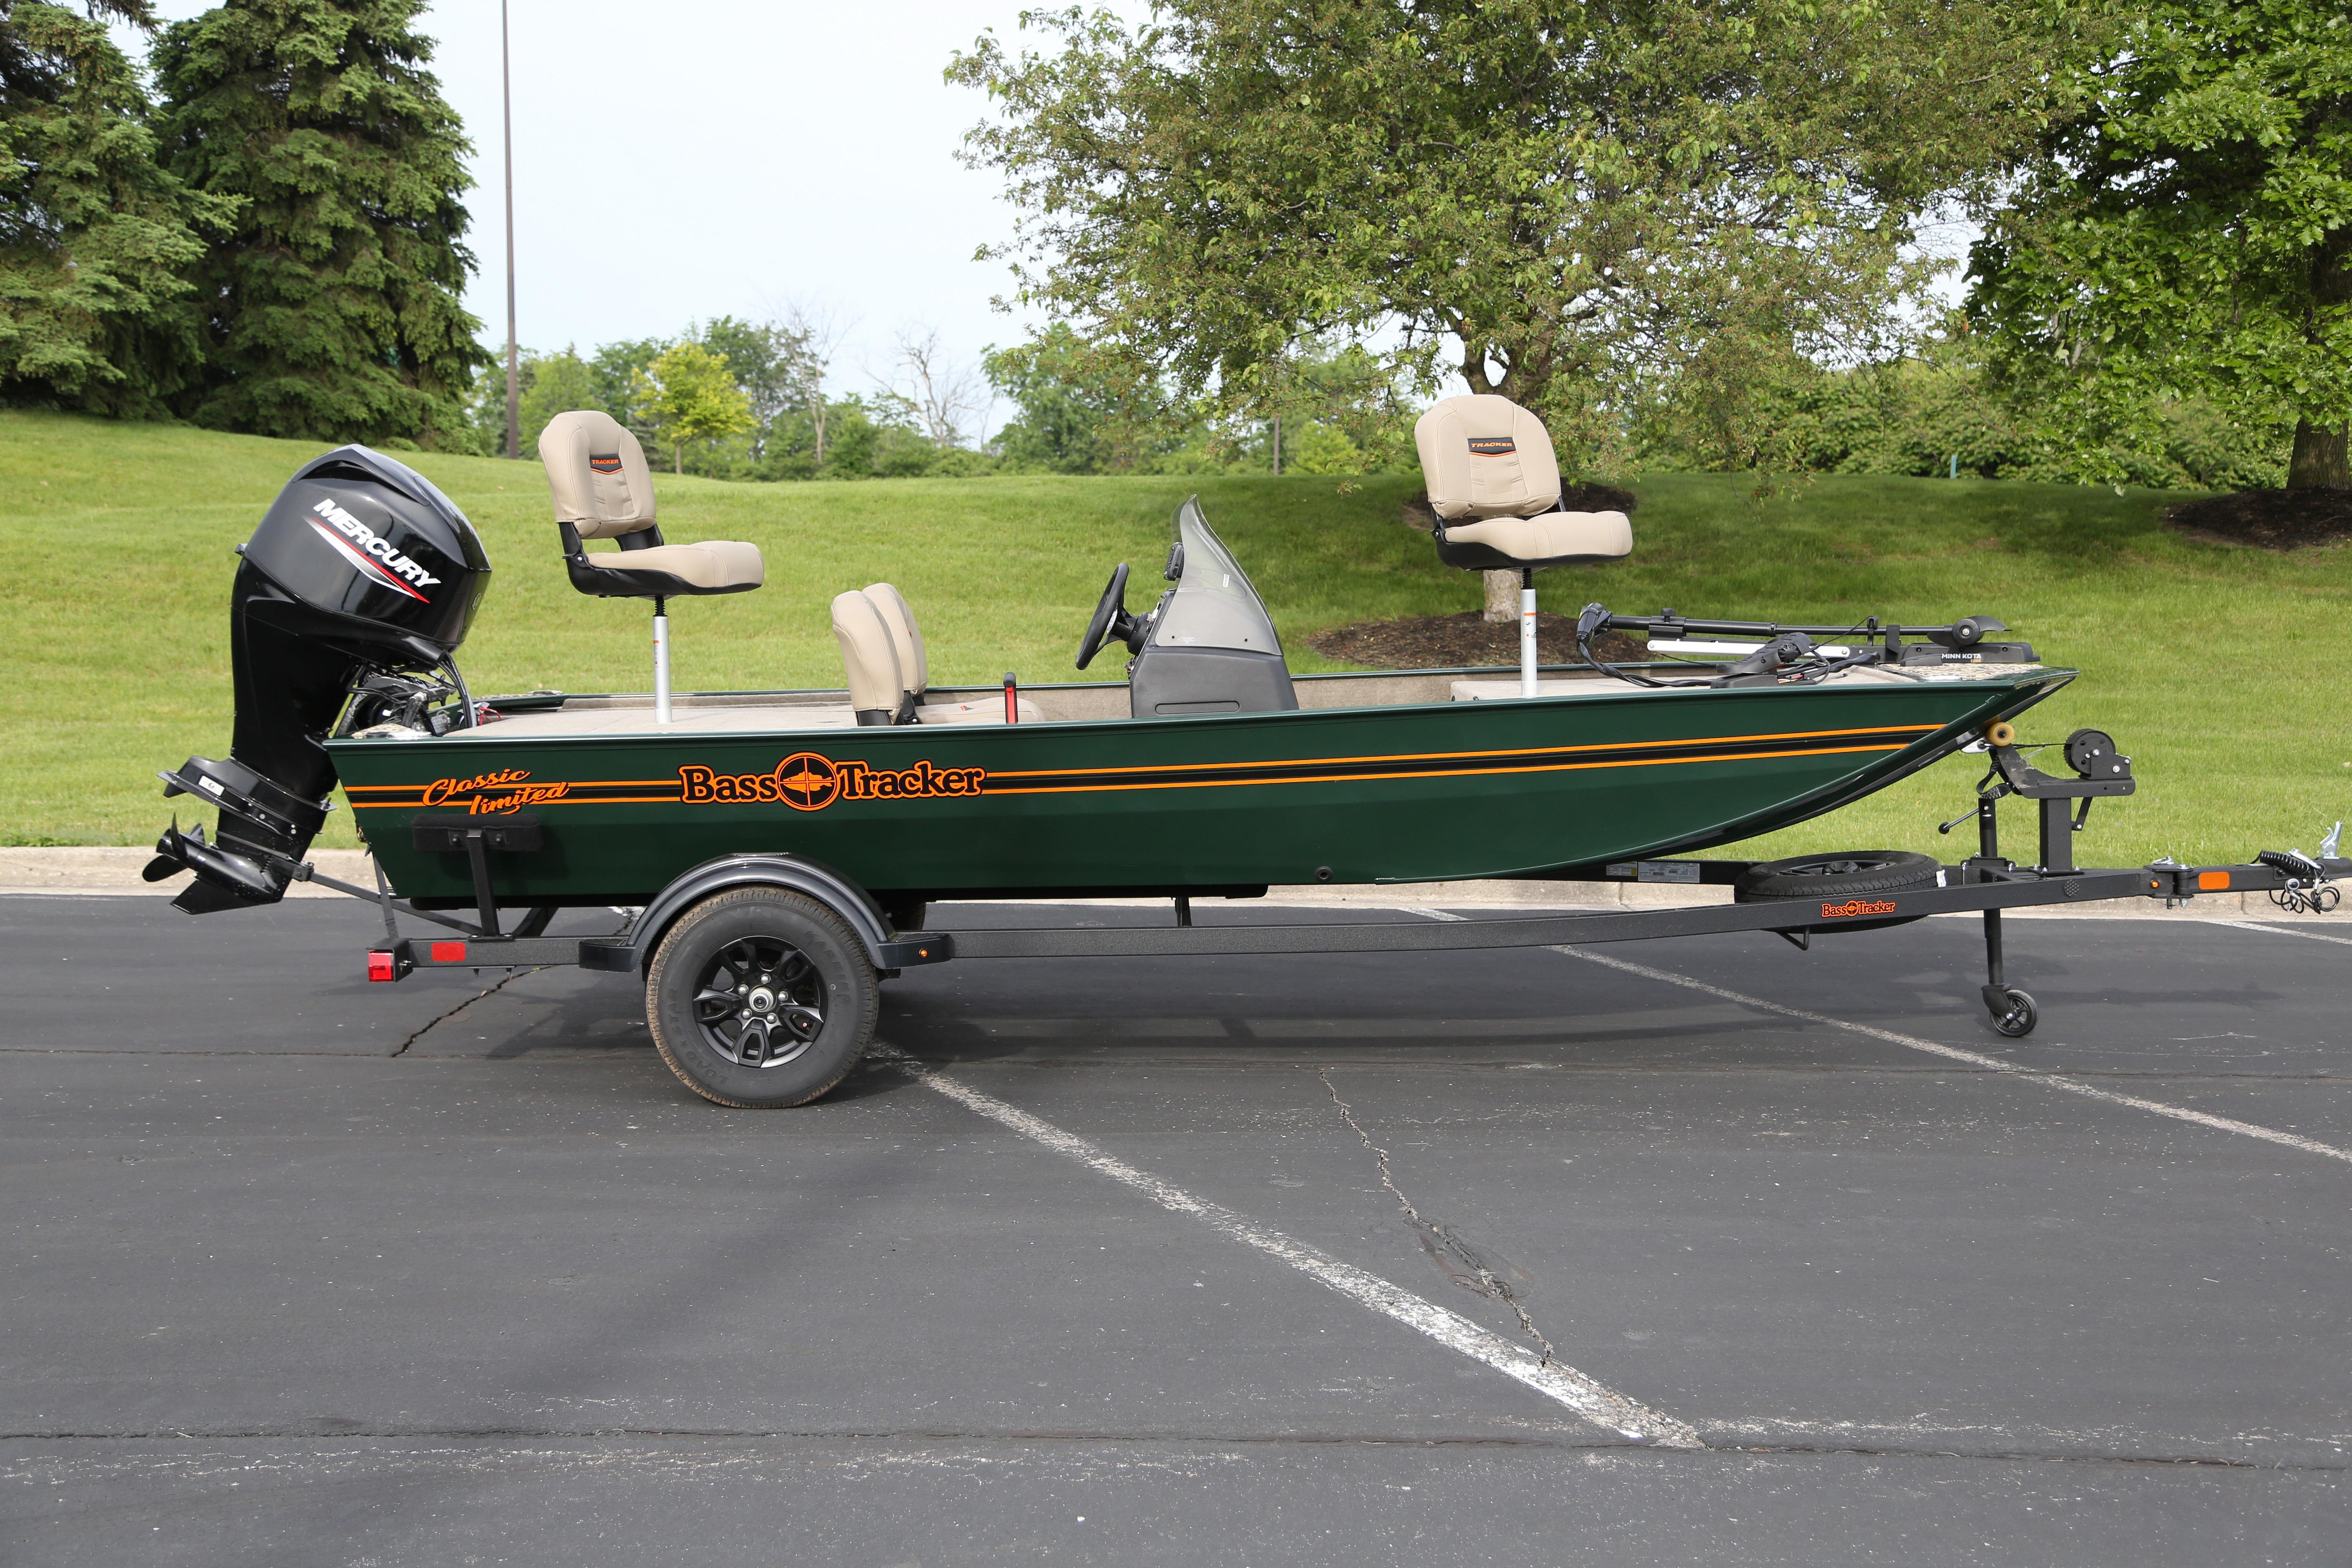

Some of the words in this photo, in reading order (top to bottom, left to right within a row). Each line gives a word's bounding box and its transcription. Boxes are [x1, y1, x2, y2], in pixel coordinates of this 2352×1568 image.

[313, 499, 441, 587] MERCURY
[422, 768, 531, 806] Classic
[679, 765, 777, 803] Bass
[834, 760, 985, 799] Tracker
[1822, 903, 1847, 917] Bass
[1858, 900, 1896, 914] Tracker
[667, 988, 684, 1036] STAR
[685, 1050, 729, 1085] LOAD
